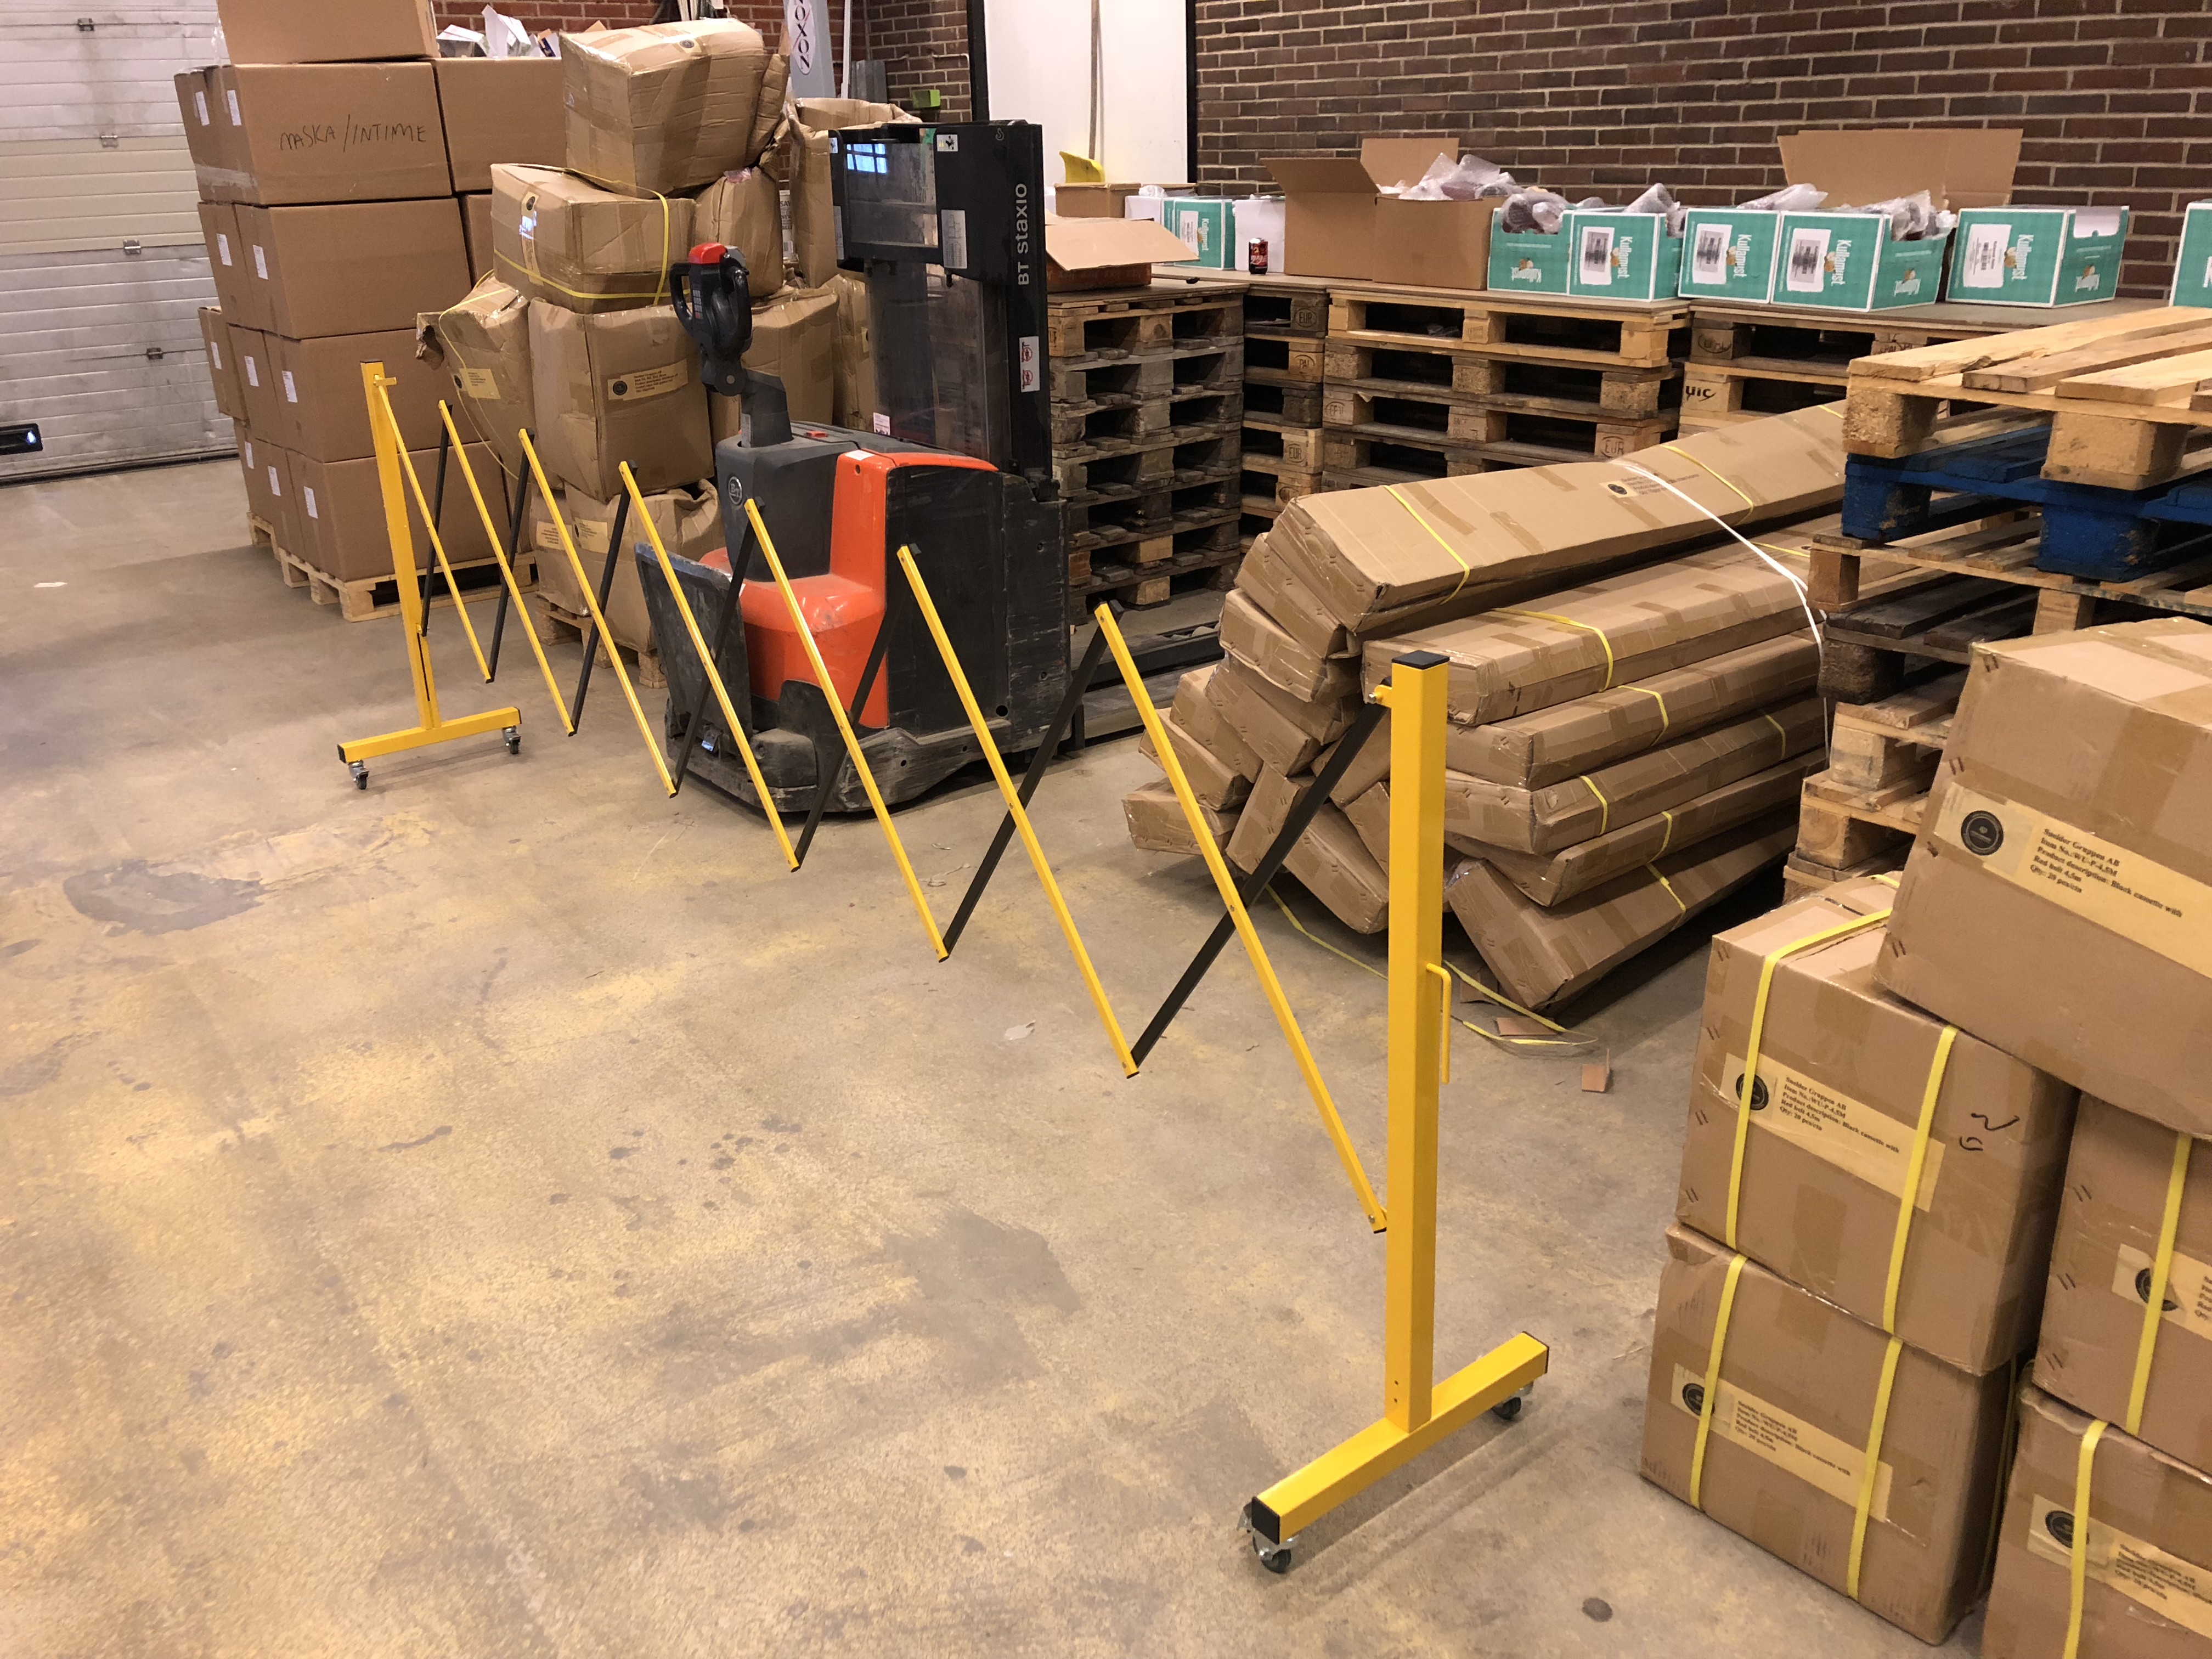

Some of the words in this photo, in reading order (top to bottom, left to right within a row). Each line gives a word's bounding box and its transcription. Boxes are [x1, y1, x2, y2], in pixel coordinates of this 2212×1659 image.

[793, 0, 811, 69] OXON
[1018, 261, 1030, 286] BT
[1783, 1092, 1805, 1106] Product
